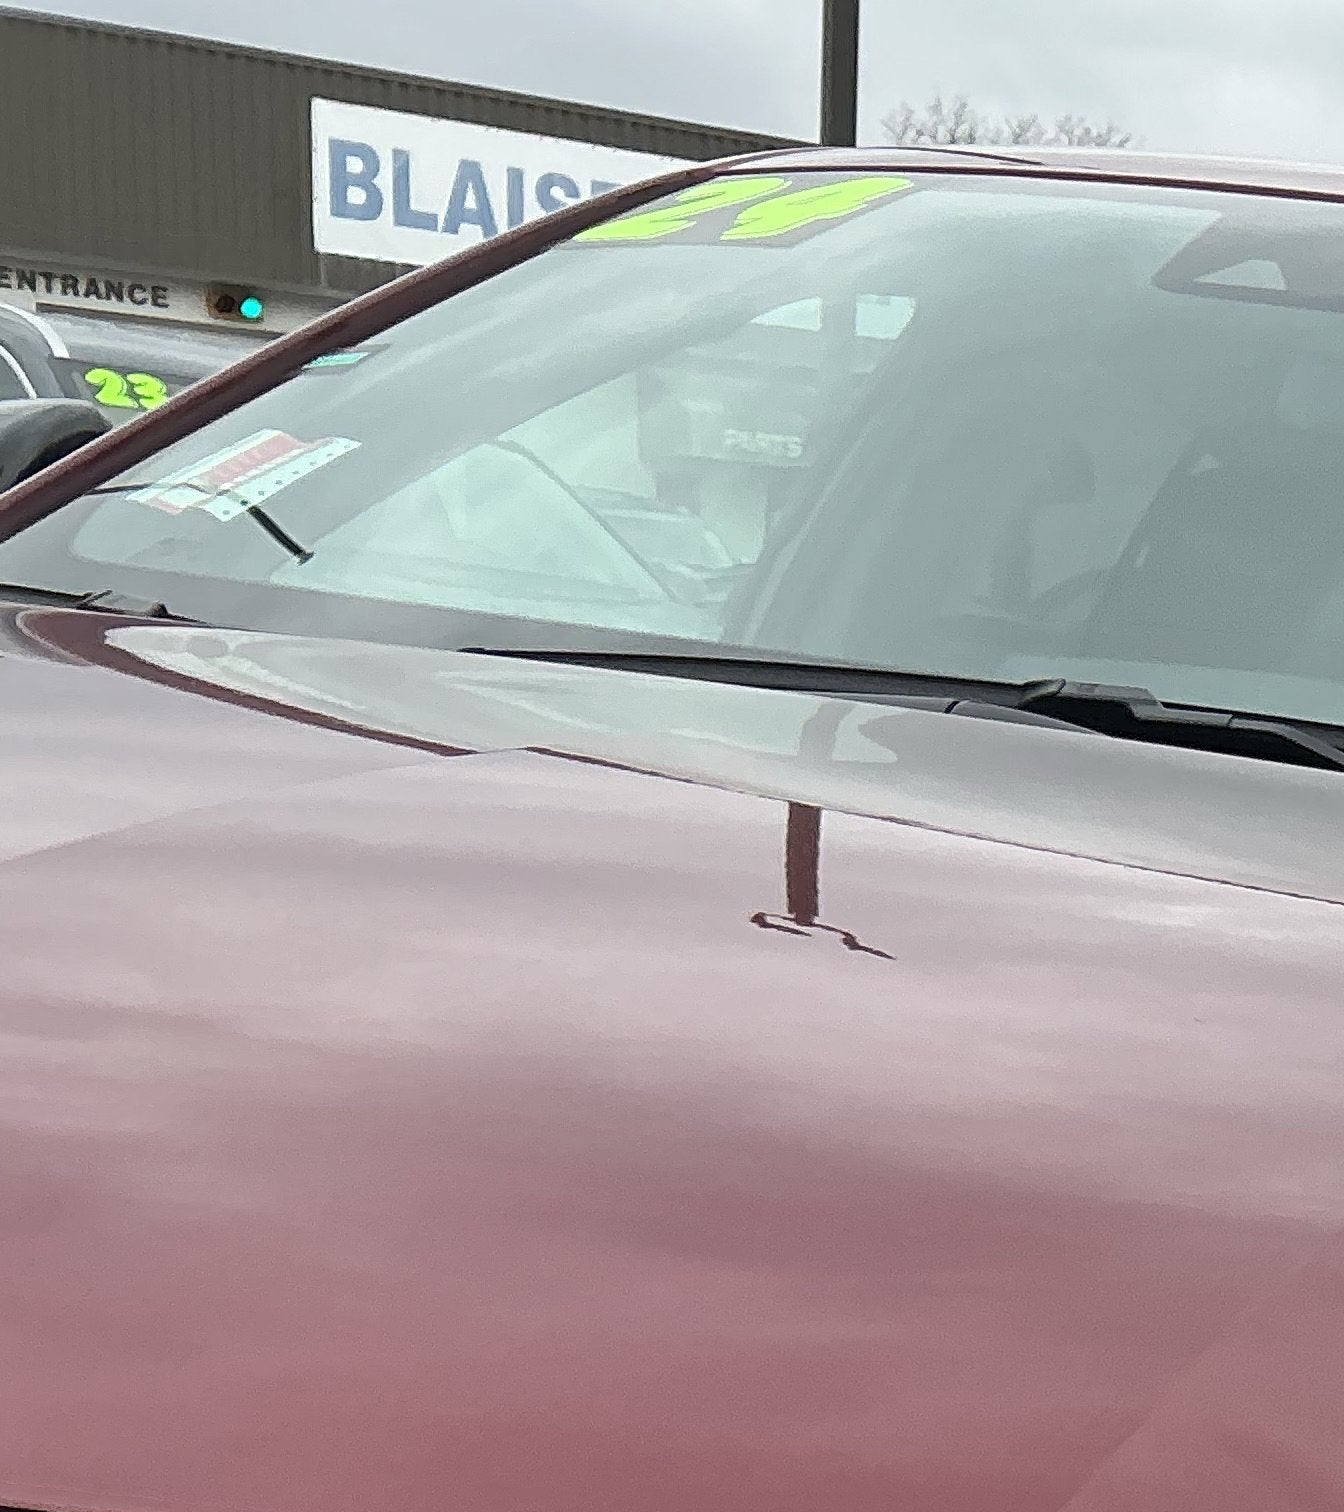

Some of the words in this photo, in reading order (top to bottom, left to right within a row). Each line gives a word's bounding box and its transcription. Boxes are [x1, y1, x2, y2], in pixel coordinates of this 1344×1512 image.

[328, 137, 626, 240] BLAIS
[572, 176, 915, 242] 24
[84, 367, 168, 411] 23
